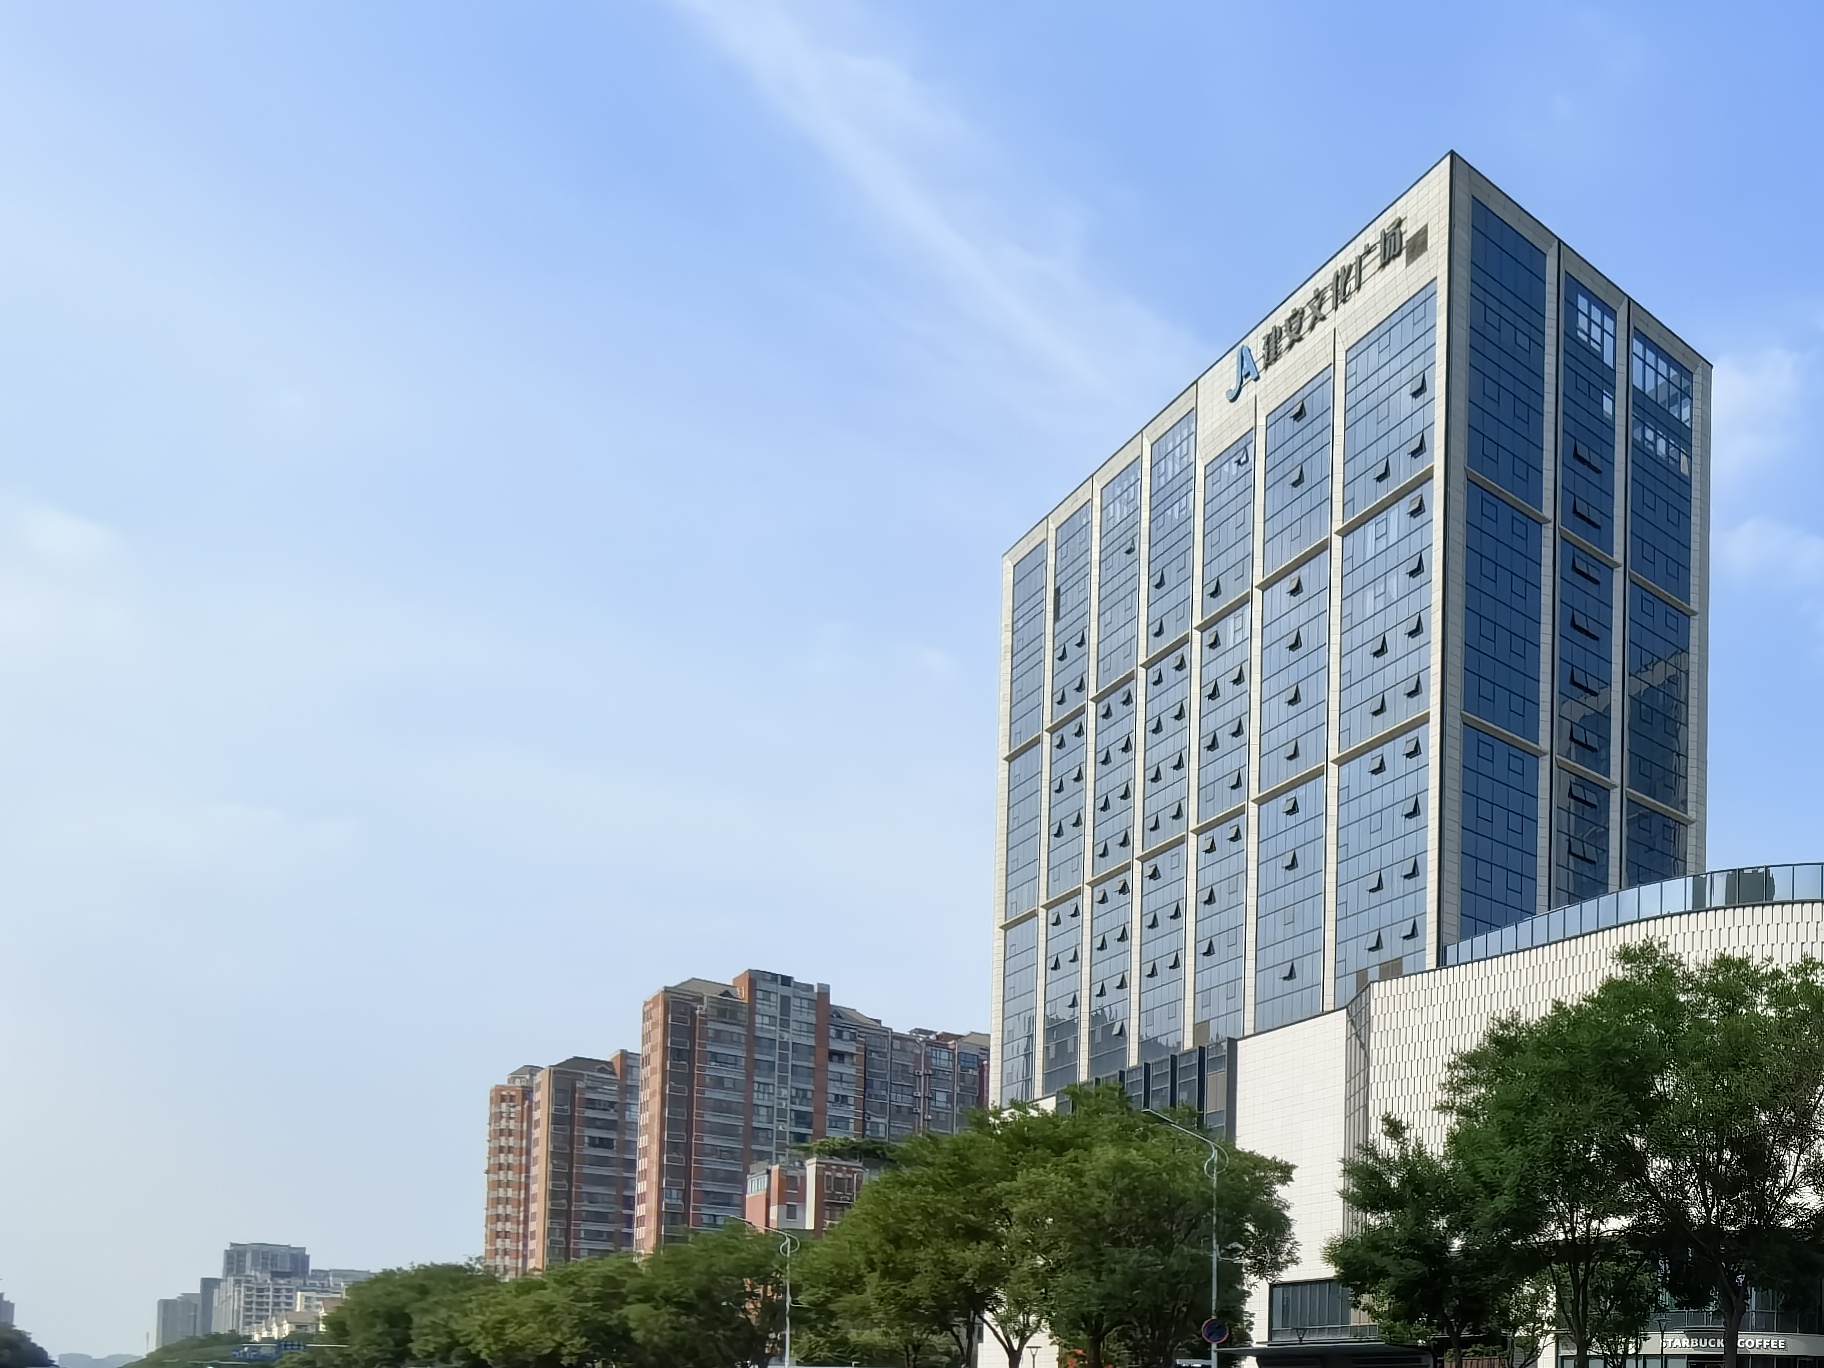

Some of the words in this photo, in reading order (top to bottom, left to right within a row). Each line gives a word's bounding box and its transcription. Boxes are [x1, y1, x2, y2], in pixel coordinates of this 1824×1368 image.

[1262, 216, 1404, 369] 建安文化广场
[1660, 1338, 1724, 1349] STARBUCK
[1737, 1338, 1786, 1350] COFFEE
